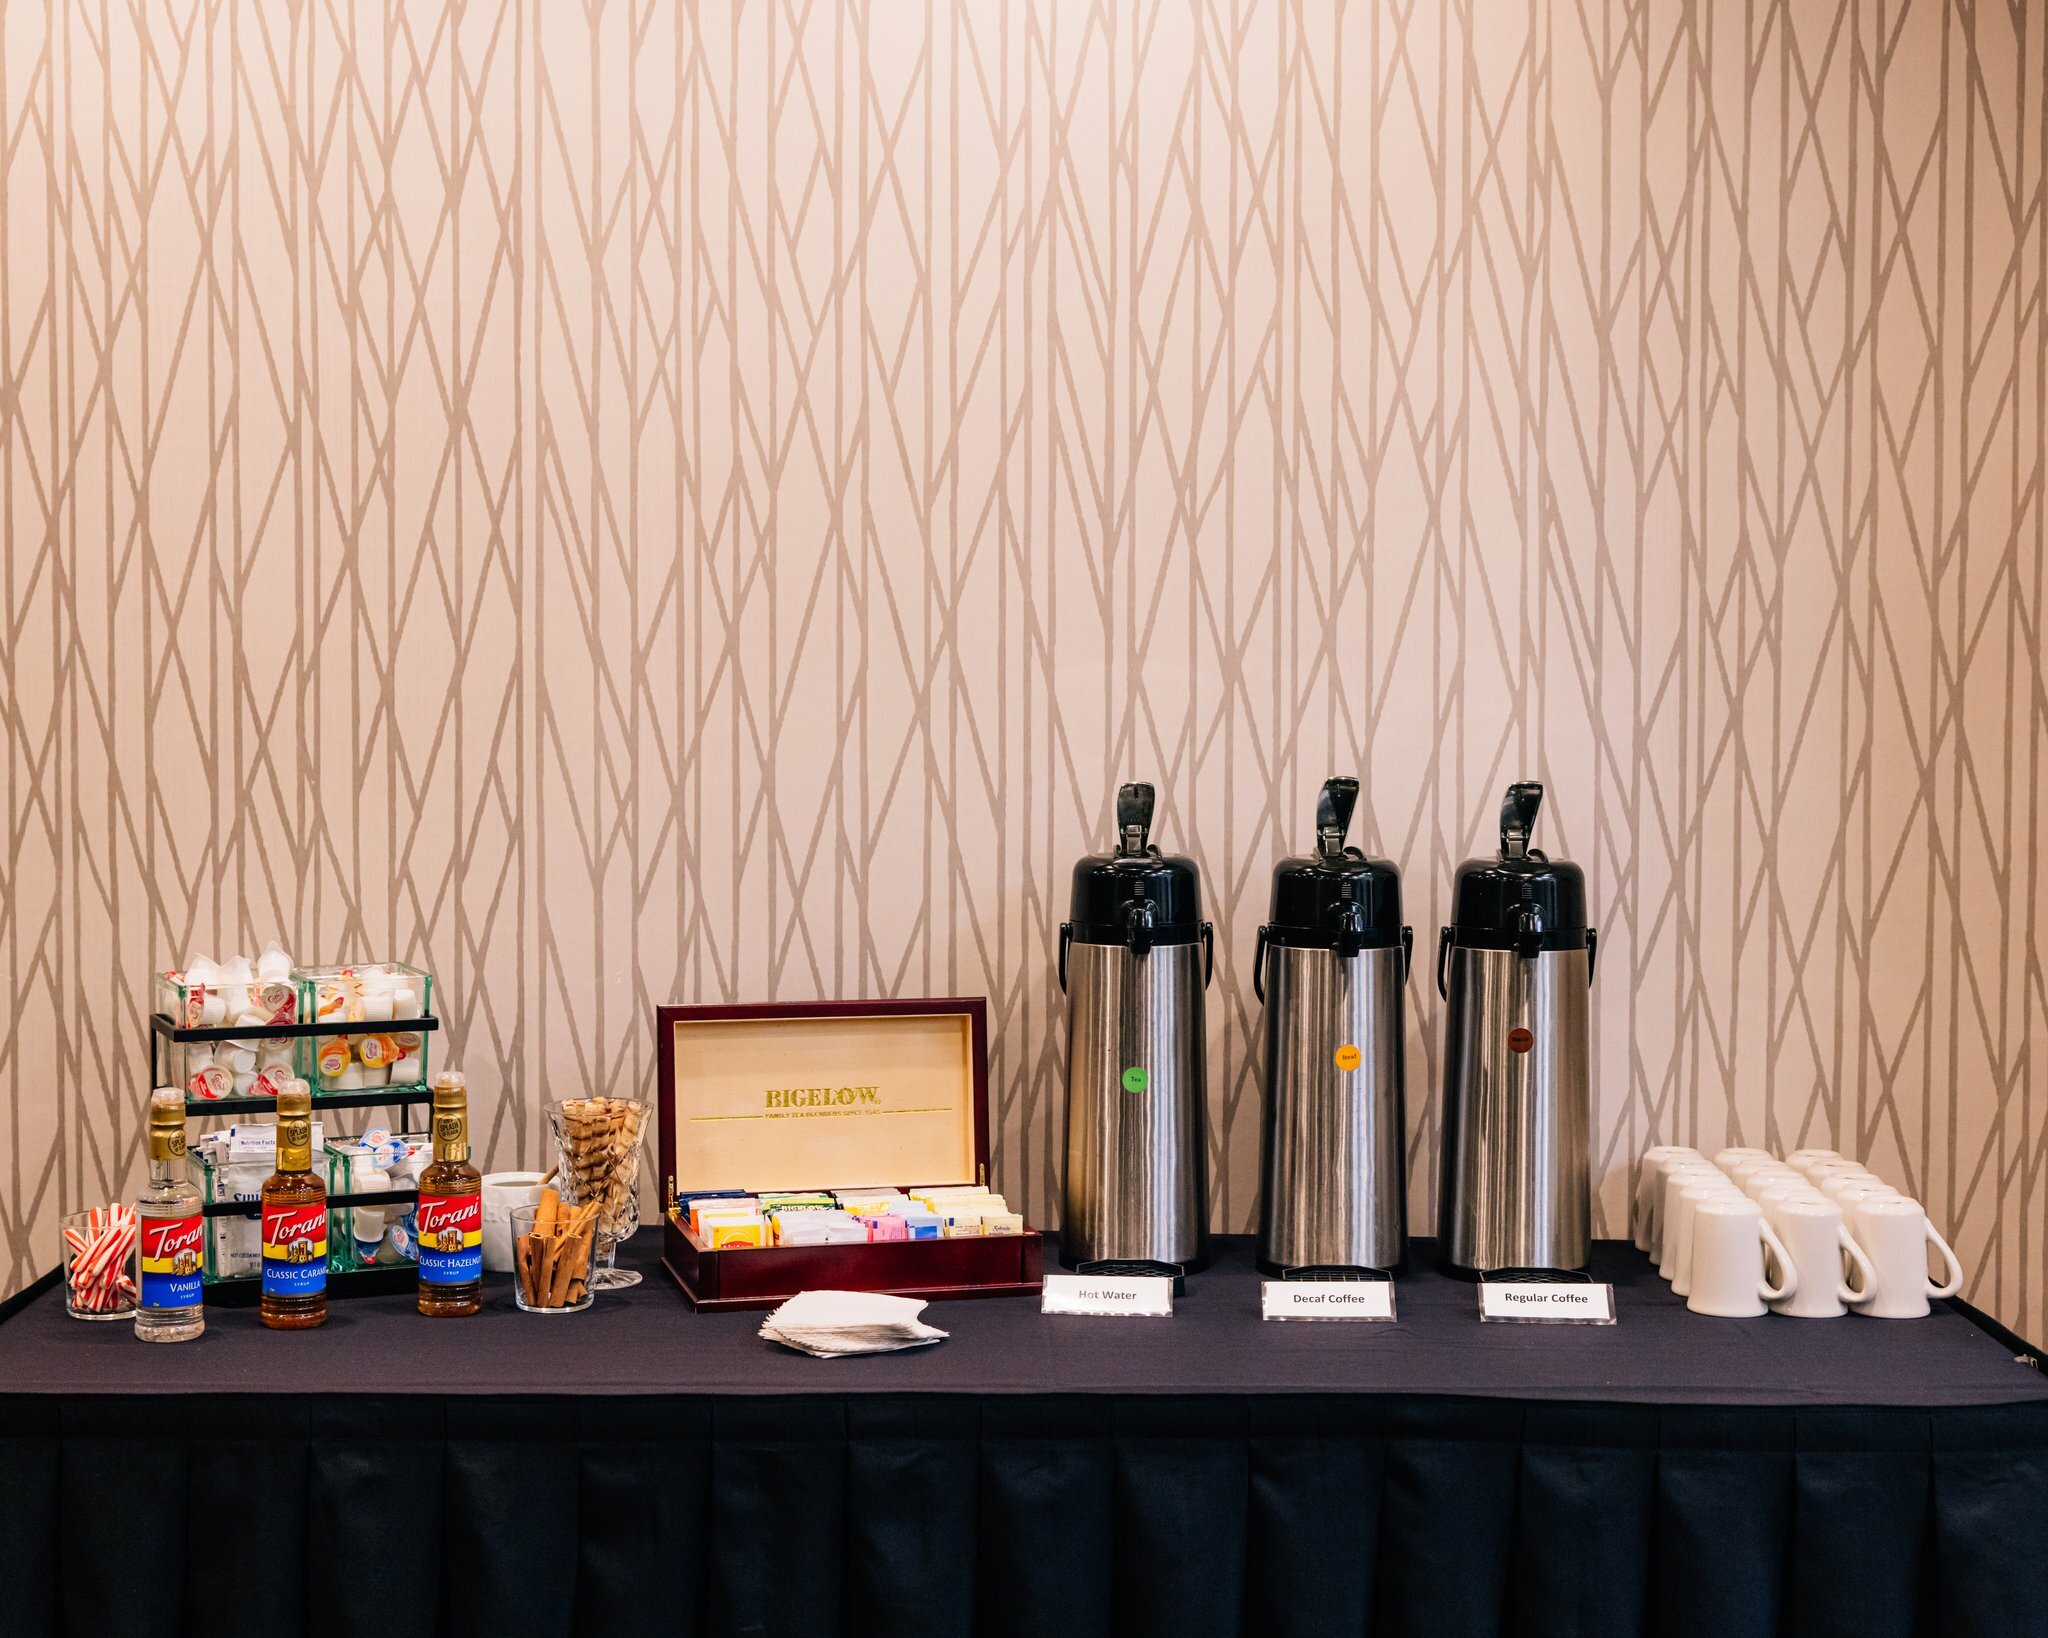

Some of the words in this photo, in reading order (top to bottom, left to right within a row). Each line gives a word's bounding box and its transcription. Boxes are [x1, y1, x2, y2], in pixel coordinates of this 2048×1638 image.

[764, 1086, 880, 1108] BIGELOW
[440, 1121, 459, 1132] SPLASH
[421, 1196, 479, 1236] Torani
[267, 1204, 326, 1248] Torani
[420, 1256, 445, 1268] CLASSIC
[266, 1268, 299, 1280] CLASSIC
[169, 1280, 201, 1293] VANILLA
[1078, 1290, 1099, 1300] Hot
[1102, 1290, 1137, 1301] Water
[1293, 1294, 1325, 1304] Decaf
[1328, 1294, 1366, 1304] Coffee
[1505, 1292, 1548, 1304] Regular
[1551, 1293, 1589, 1304] Coffee
